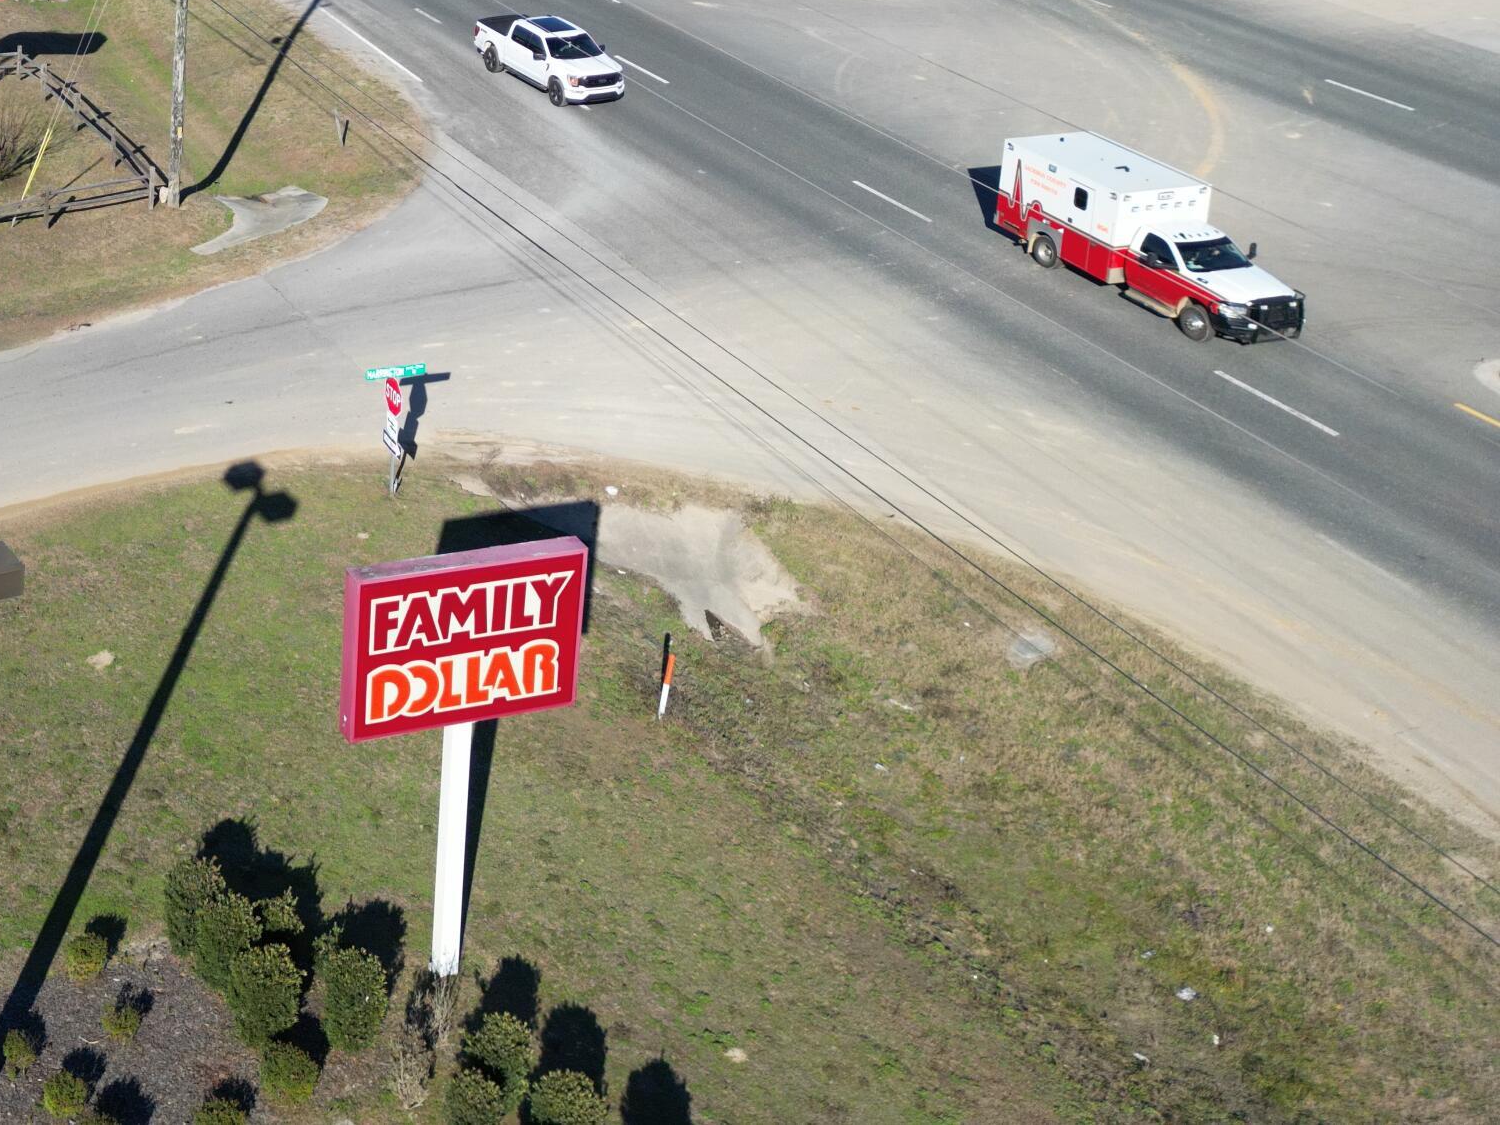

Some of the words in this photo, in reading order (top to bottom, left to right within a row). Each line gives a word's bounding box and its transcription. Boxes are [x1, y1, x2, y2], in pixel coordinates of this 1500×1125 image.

[386, 384, 401, 407] STOP
[369, 570, 575, 656] FAMILY
[365, 638, 560, 725] DOLLAR
